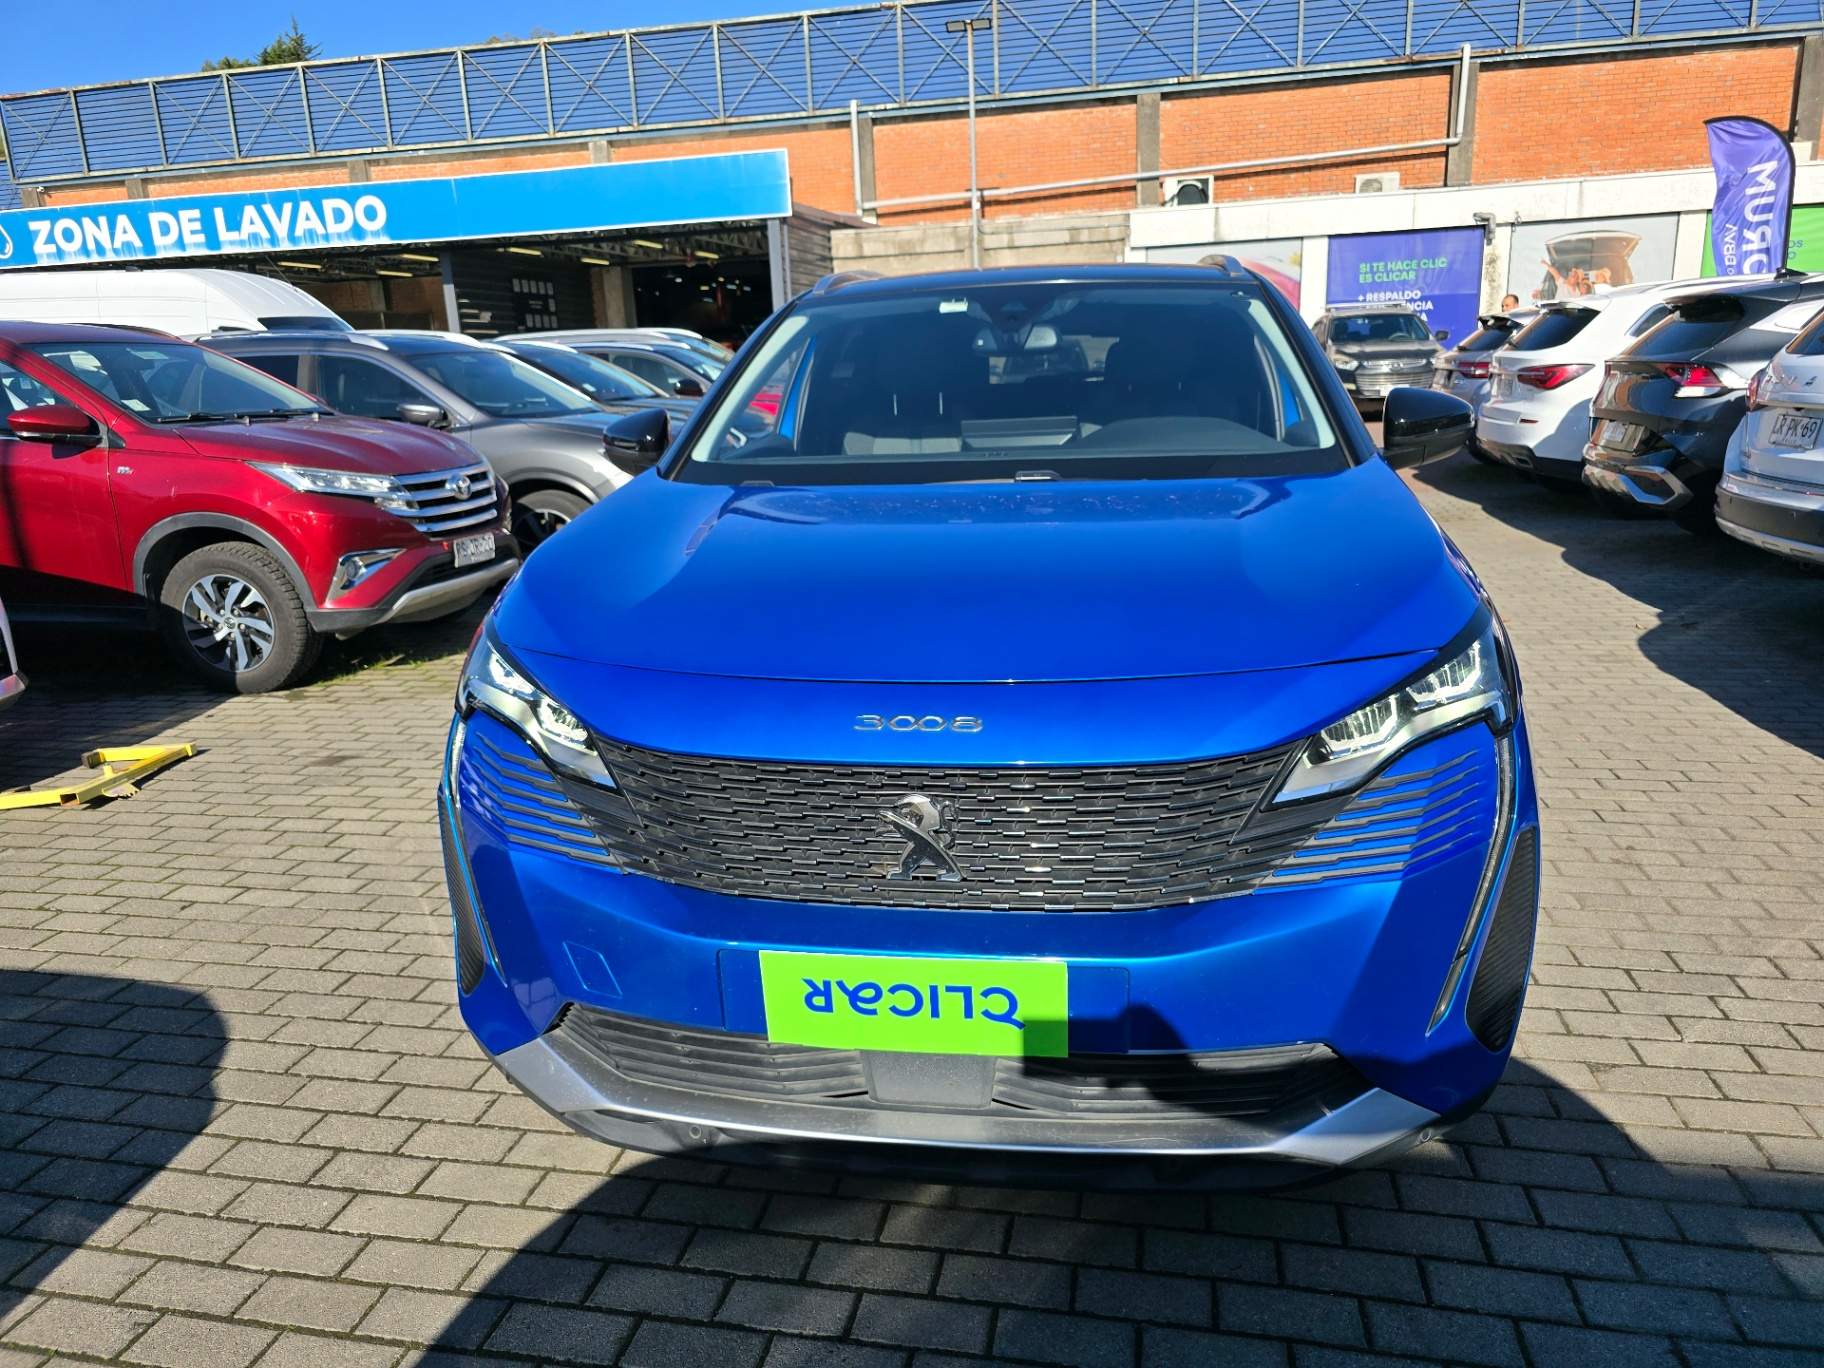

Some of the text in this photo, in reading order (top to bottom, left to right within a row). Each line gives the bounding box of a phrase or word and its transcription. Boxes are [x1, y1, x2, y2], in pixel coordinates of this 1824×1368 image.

[28, 195, 388, 254] ZONA DE LAVADO
[1359, 257, 1448, 273] SI TE HACE CLIC
[1359, 271, 1417, 283] ES CLICAR
[1365, 290, 1422, 302] RESPALDO
[853, 714, 983, 733] 3008
